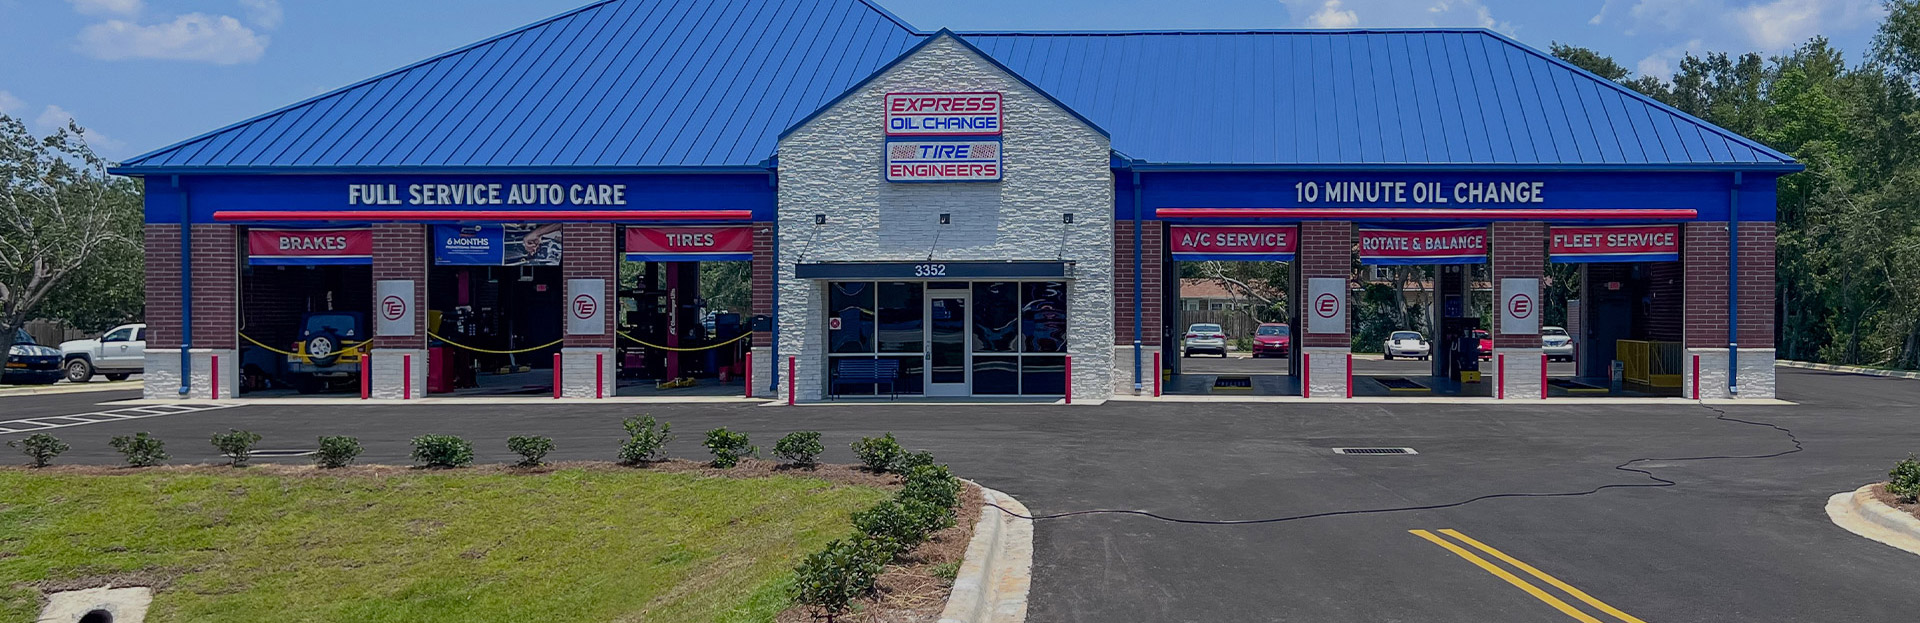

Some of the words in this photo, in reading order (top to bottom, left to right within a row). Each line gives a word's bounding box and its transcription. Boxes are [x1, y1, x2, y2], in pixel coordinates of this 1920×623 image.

[891, 97, 997, 112] EXPRESS
[891, 117, 919, 130] OIL
[922, 116, 998, 130] CHANGE
[919, 144, 970, 159] TIRE
[890, 164, 997, 177] ENGINEERS
[349, 184, 402, 205] FULL
[408, 184, 502, 205] SERVICE
[507, 184, 565, 205] AUTO
[569, 184, 627, 205] CARE
[1295, 181, 1319, 203] 10
[1325, 181, 1407, 203] MINUTE
[1412, 181, 1448, 204] OIL
[1453, 181, 1544, 203] CHANGE
[279, 236, 347, 250] BRAKES
[446, 237, 453, 246] 6
[453, 238, 489, 246] MONTHS
[666, 233, 715, 247] TIRES
[1181, 231, 1211, 248] A/C
[1216, 232, 1287, 247] SERVICE
[1362, 237, 1409, 251] ROTATE
[1412, 237, 1422, 250] &
[1425, 235, 1483, 250] BALANCE
[1553, 233, 1603, 248] FLEET
[1606, 232, 1675, 247] SERVICE
[915, 264, 946, 277] 3352
[384, 301, 402, 316] TE
[576, 299, 594, 315] TE
[1320, 299, 1335, 312] E
[1513, 300, 1528, 313] E
